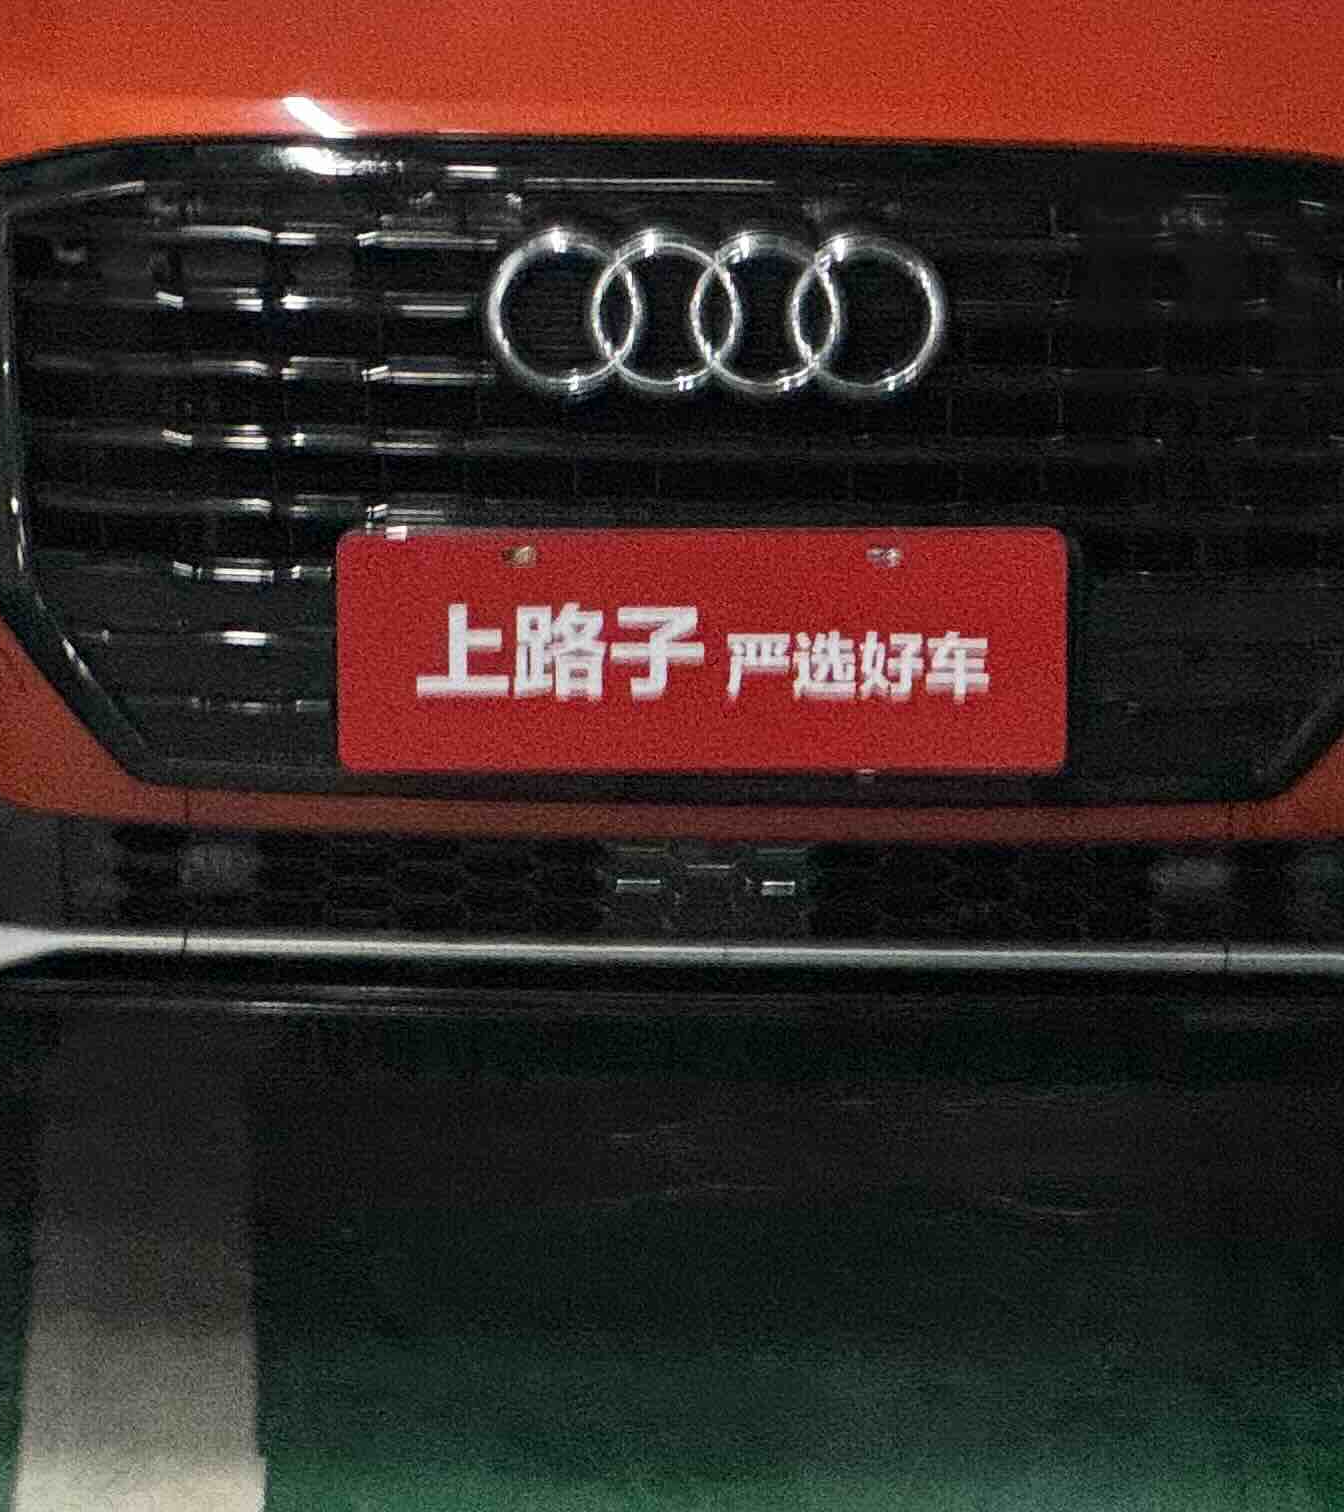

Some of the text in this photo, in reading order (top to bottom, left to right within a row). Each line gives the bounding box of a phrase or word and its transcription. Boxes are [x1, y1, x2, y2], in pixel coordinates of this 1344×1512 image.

[416, 602, 991, 704] 上路子 严选好车
